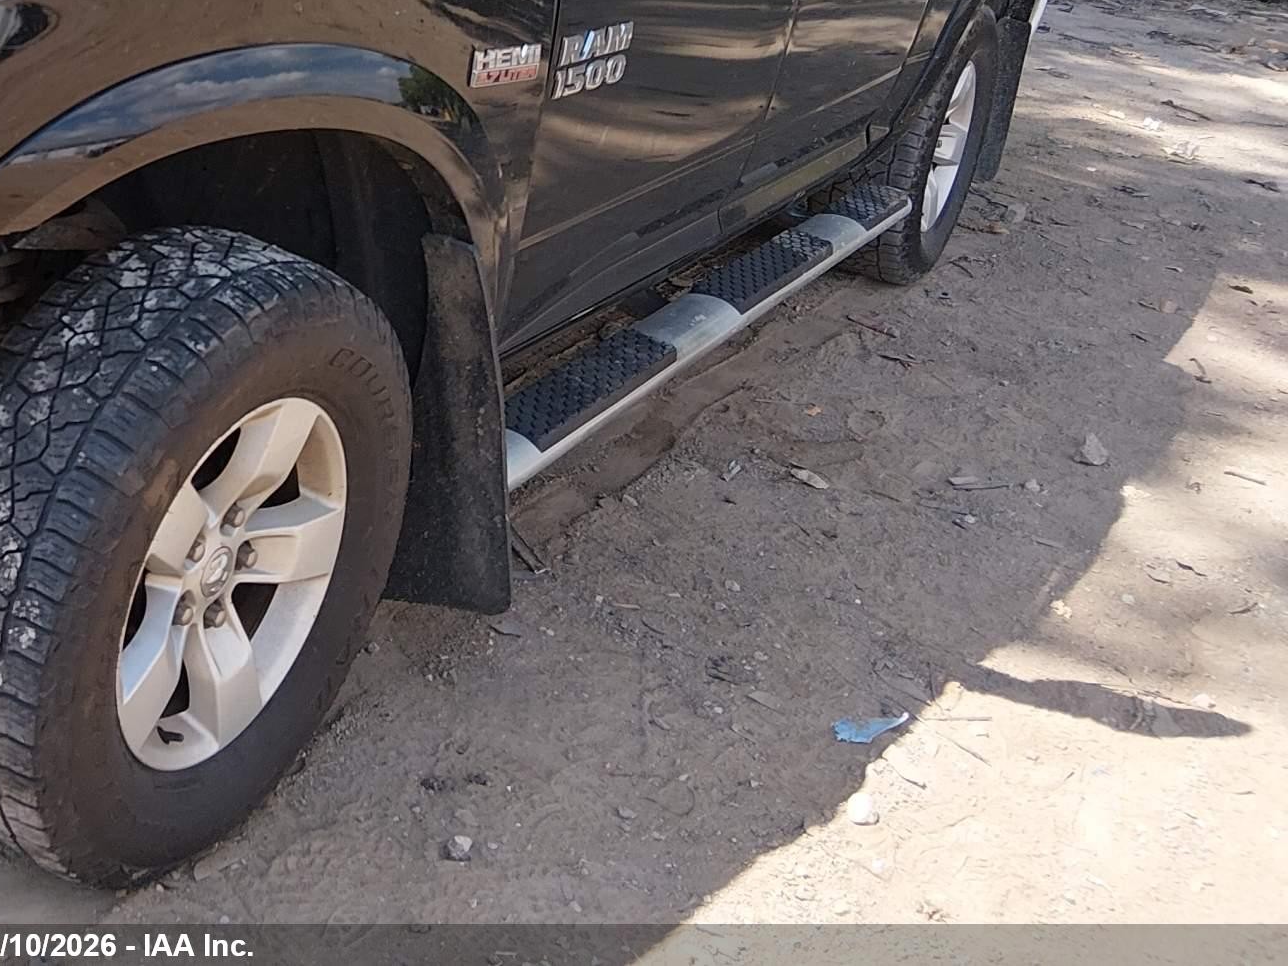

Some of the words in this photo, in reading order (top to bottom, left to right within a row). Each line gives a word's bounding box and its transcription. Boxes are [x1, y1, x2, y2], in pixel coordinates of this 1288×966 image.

[474, 43, 543, 72] HEMI
[559, 21, 634, 67] RAM
[552, 54, 627, 100] 1500
